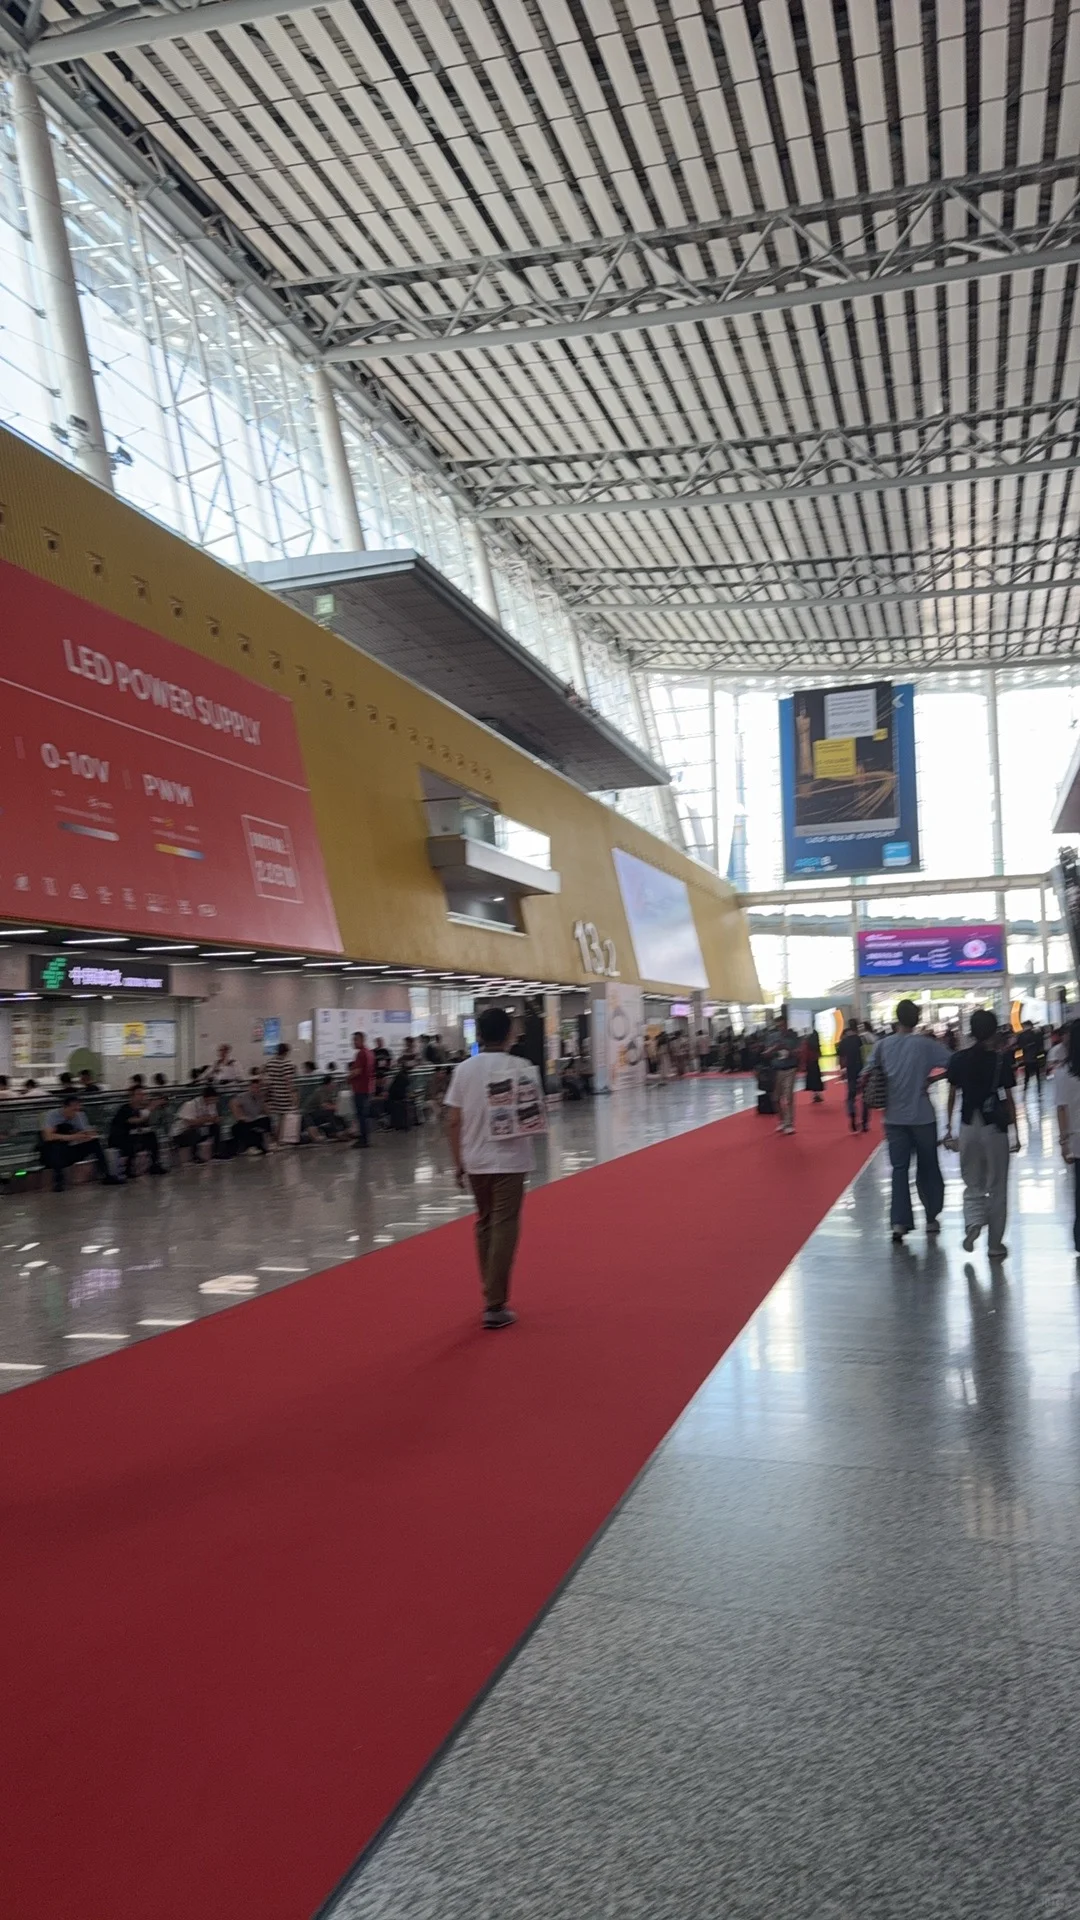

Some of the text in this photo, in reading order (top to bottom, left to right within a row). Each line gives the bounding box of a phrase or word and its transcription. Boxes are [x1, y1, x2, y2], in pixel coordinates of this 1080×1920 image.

[63, 639, 262, 746] LED POWER SUPPLY
[142, 773, 195, 808] PWM
